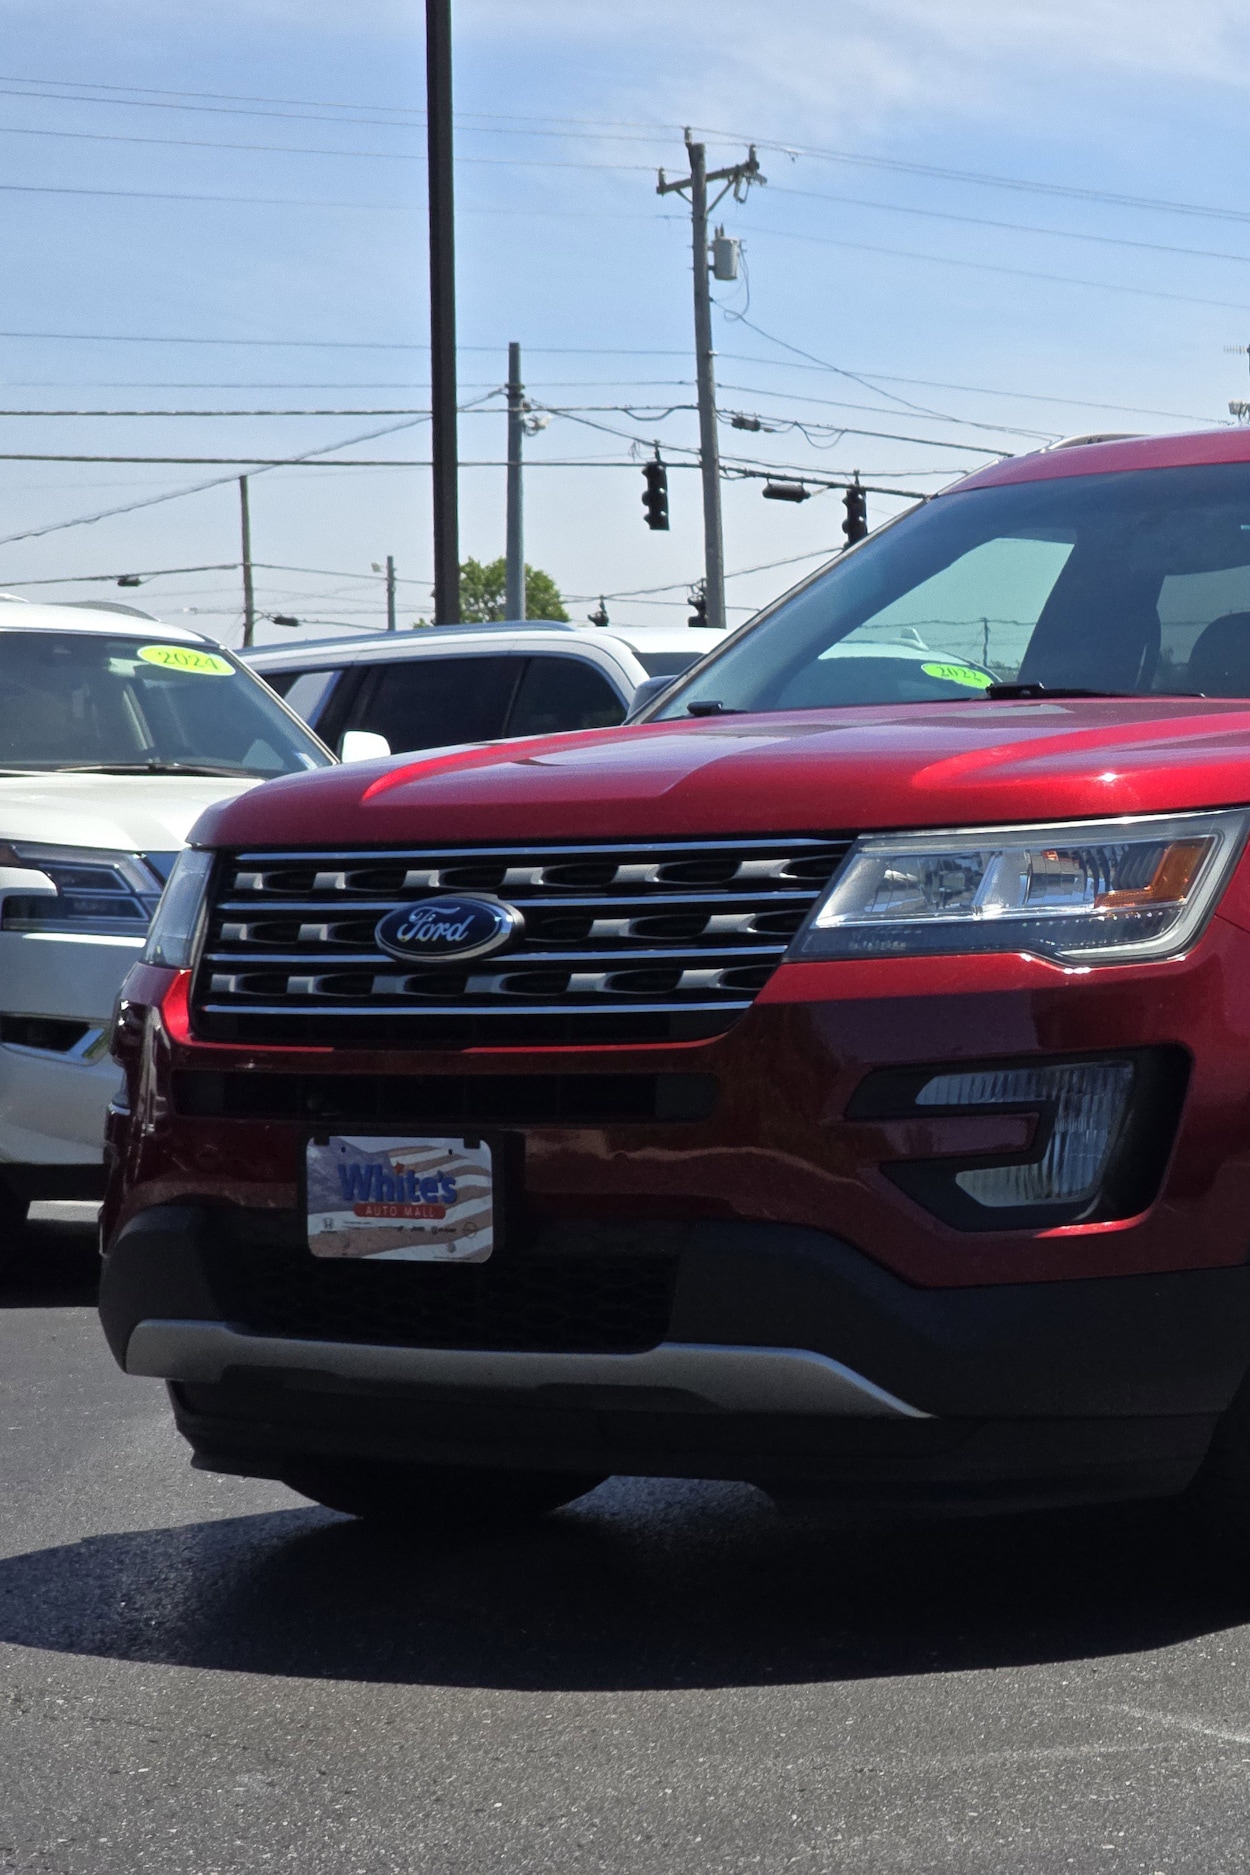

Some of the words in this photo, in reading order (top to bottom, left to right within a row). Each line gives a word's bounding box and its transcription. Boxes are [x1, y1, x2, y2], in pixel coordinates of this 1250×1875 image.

[158, 651, 219, 670] 2021
[397, 906, 475, 942] Ford
[338, 1162, 458, 1204] White's
[365, 1206, 397, 1217] AUTO
[404, 1206, 435, 1218] MALL
